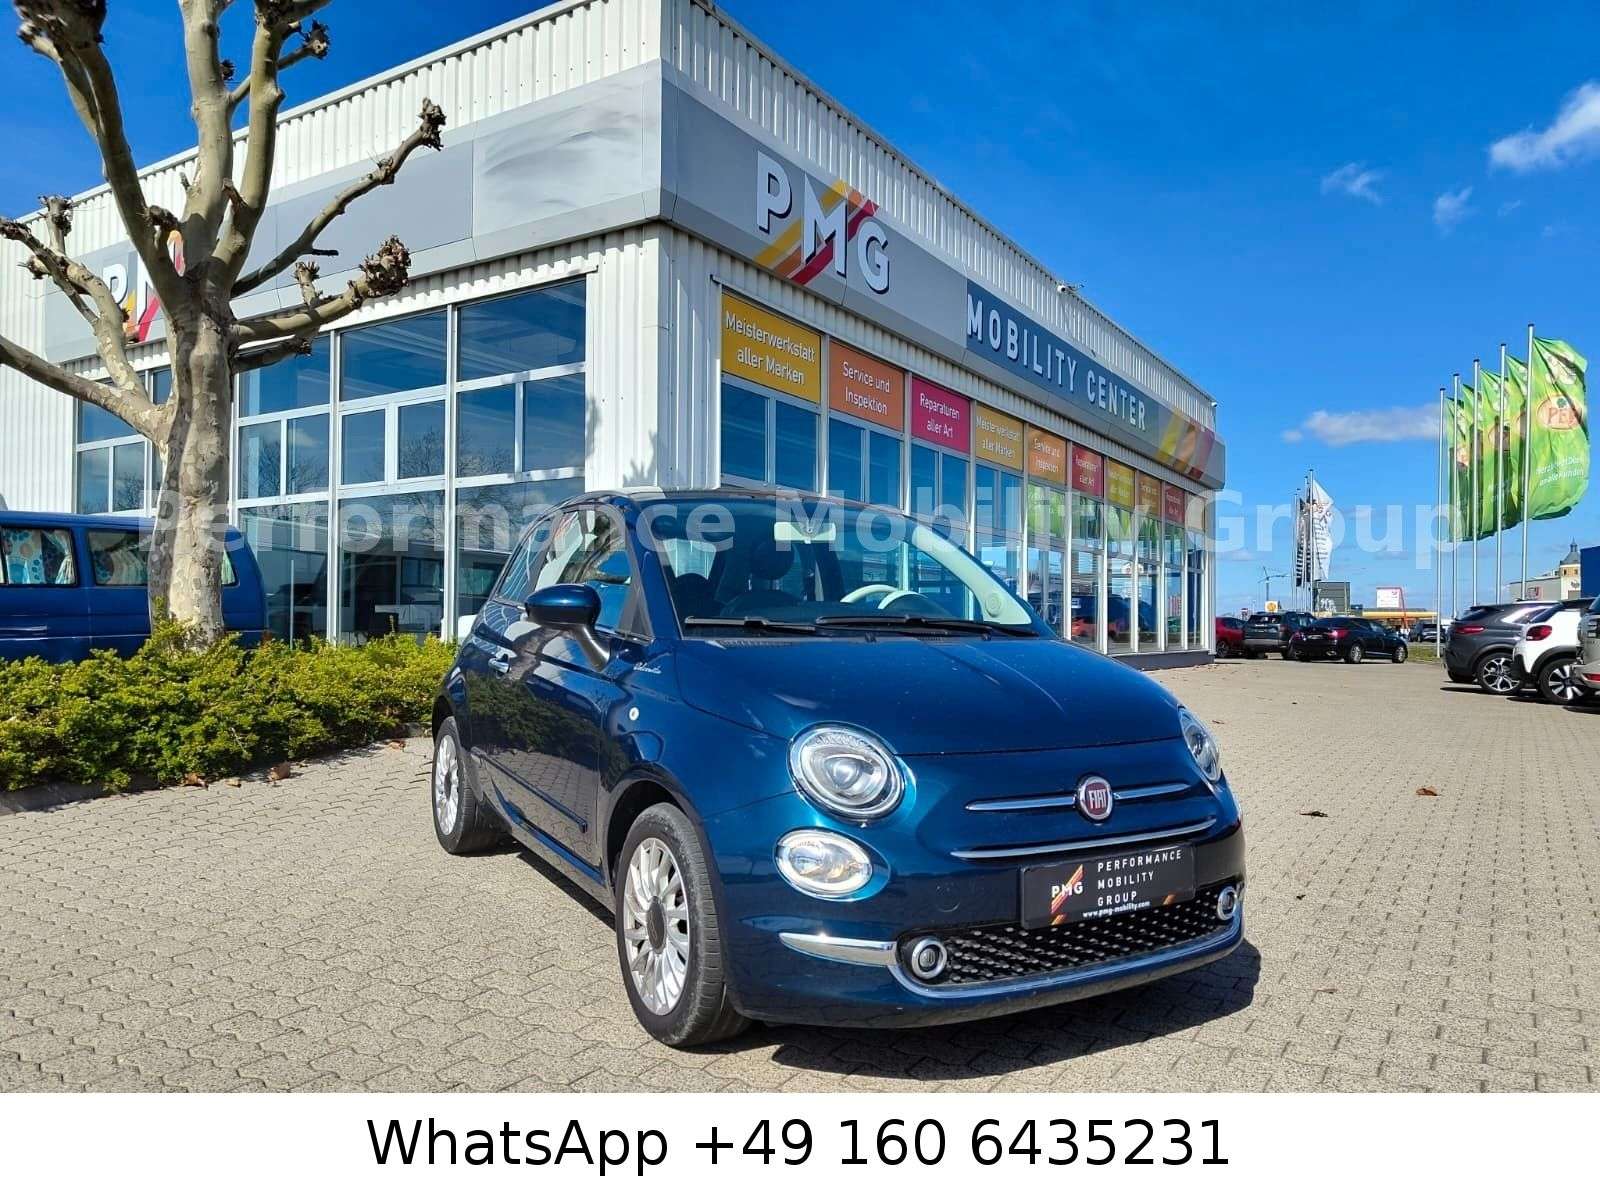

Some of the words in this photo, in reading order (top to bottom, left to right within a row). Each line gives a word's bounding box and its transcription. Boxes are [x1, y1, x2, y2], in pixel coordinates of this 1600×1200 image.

[757, 150, 890, 295] PMG
[725, 310, 816, 363] Meisterwerkstatt
[737, 347, 763, 368] aller
[765, 354, 804, 386] Marken
[967, 293, 1077, 393] MOBILITY
[1087, 369, 1146, 431] CENTER
[842, 361, 874, 388] Service
[875, 375, 890, 393] und
[845, 387, 888, 416] Inspektion
[919, 392, 960, 420] Reparaturen
[926, 418, 942, 434] aller
[943, 422, 953, 438] Art
[1088, 787, 1107, 809] FIAT
[1097, 849, 1182, 872] PERFORMANCE
[1051, 881, 1084, 898] PMG
[1097, 870, 1154, 890] MOBILITY
[1082, 900, 1151, 918] www.pmg-mobility.com
[1097, 890, 1137, 907] GROUP
